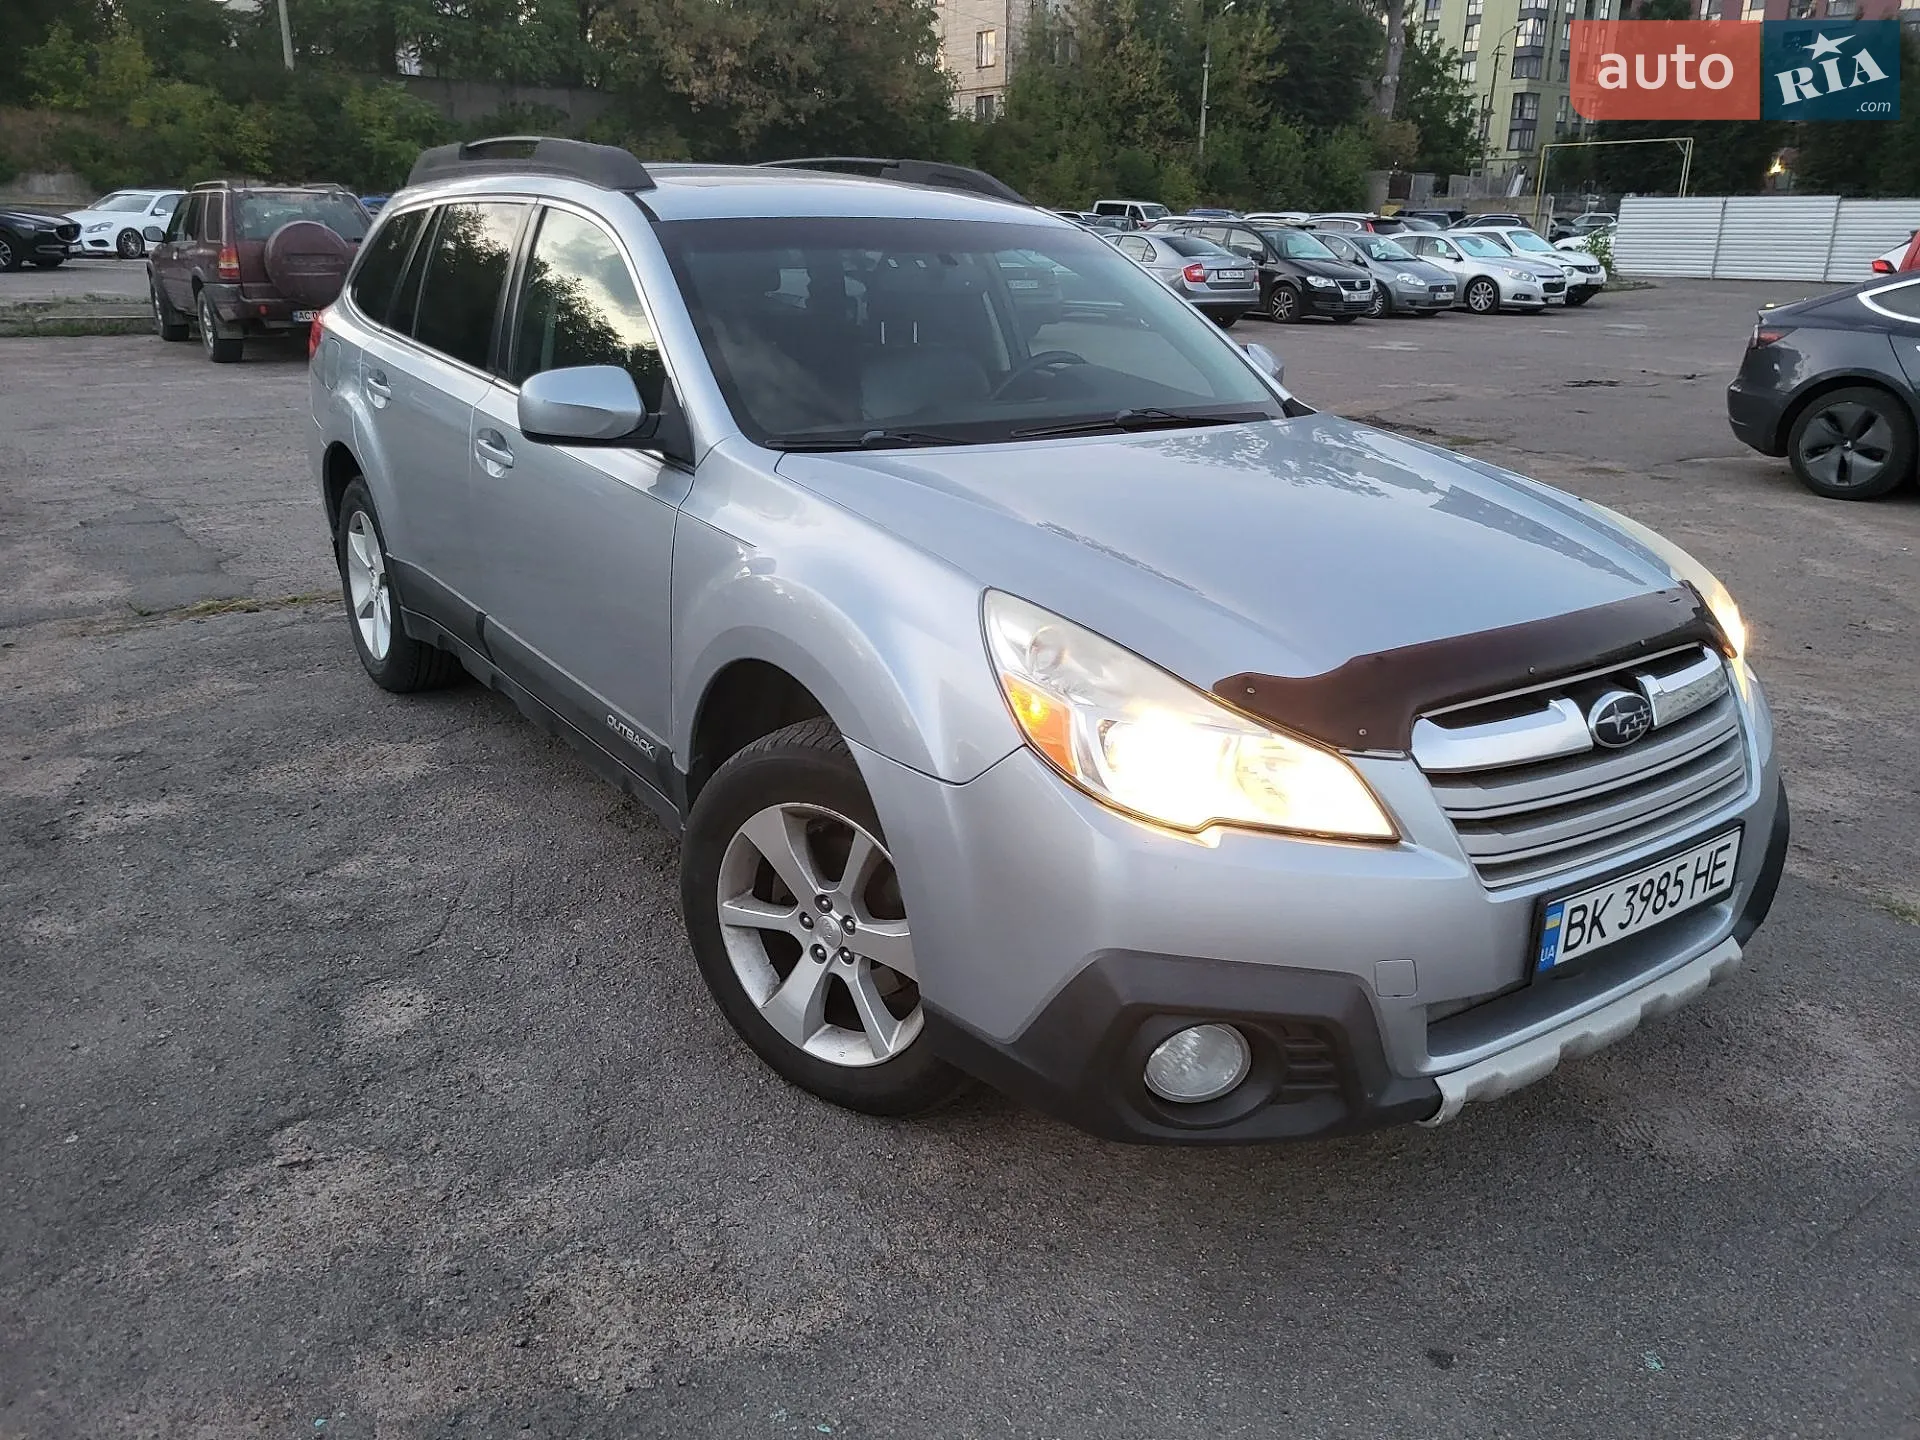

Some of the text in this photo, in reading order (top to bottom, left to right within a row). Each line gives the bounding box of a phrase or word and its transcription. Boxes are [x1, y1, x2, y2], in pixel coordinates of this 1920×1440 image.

[606, 714, 655, 758] OUTBACK
[1562, 843, 1731, 953] BK 3985 HE
[1540, 946, 1555, 963] UA
